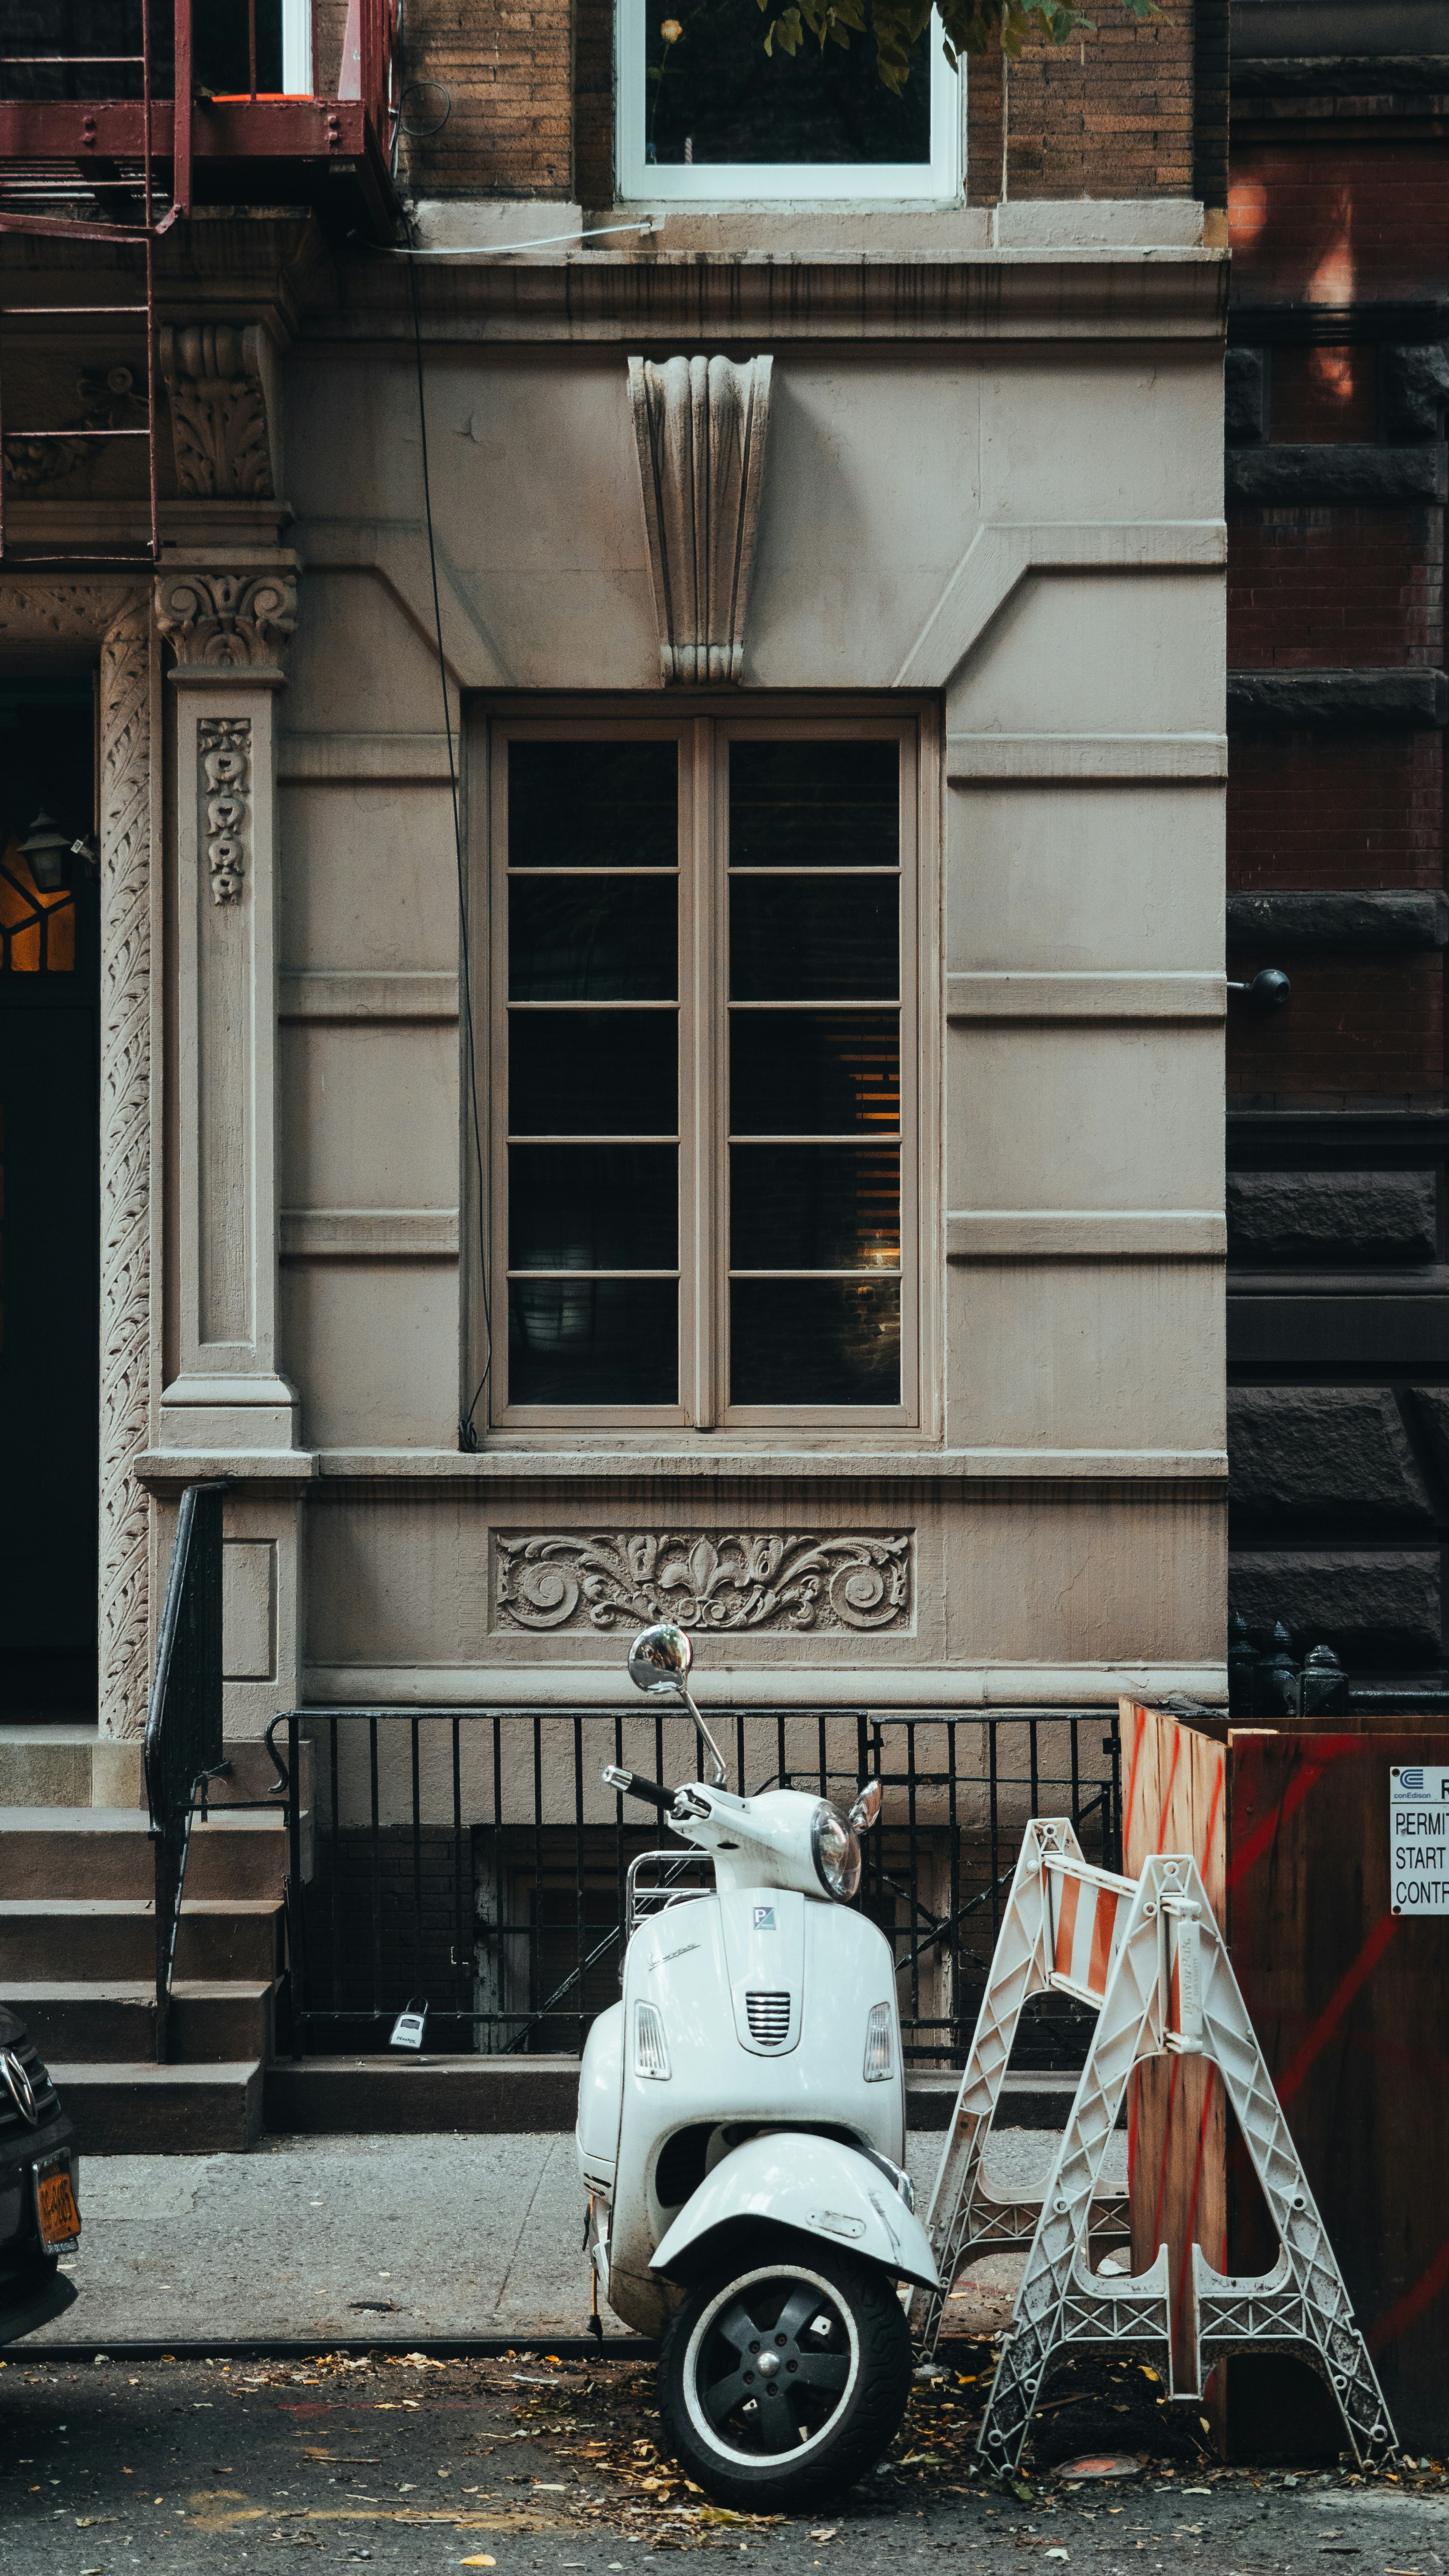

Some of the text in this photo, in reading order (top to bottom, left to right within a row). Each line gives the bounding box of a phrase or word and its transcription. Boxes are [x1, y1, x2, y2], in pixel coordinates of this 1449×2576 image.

[1396, 1813, 1449, 1835] PERMI
[1396, 1847, 1446, 1869] START
[755, 1909, 766, 1923] P
